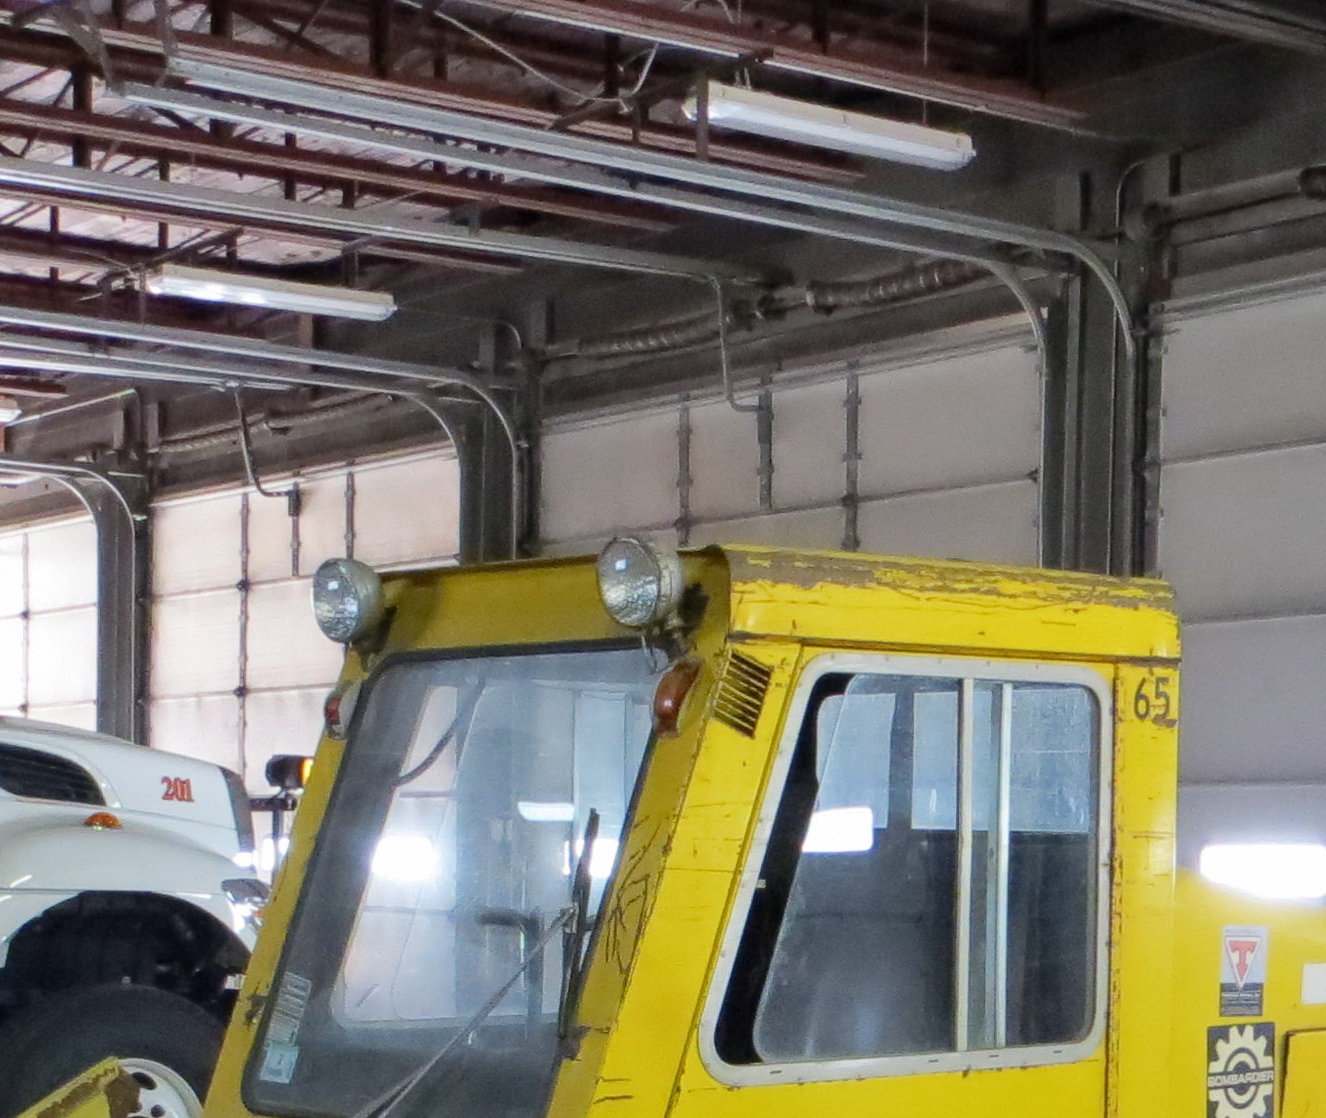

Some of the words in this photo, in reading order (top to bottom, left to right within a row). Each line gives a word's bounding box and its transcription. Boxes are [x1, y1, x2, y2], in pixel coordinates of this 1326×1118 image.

[1134, 676, 1171, 722] 65
[160, 776, 194, 802] 201
[1207, 1069, 1275, 1088] BOMBARDIER
